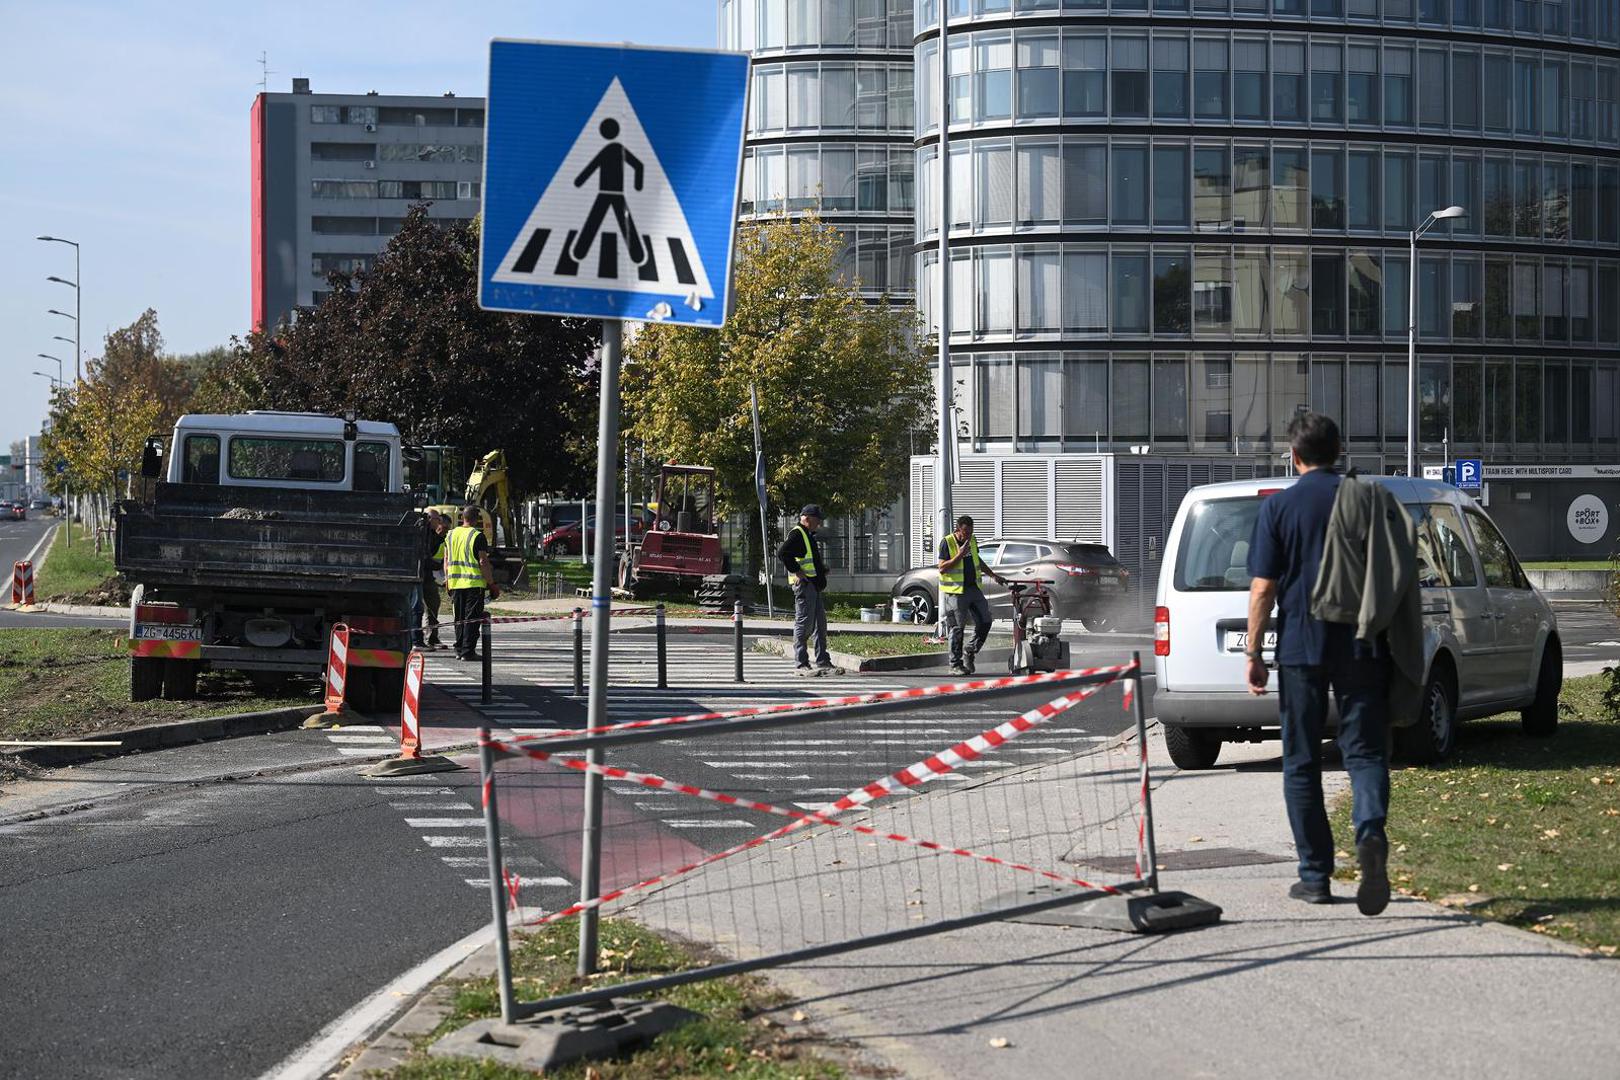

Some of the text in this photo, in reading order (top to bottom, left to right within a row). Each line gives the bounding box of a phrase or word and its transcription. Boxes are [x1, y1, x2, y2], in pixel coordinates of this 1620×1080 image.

[1462, 466, 1474, 481] P
[1485, 467, 1572, 475] TRAIN HERE WITH MULTISPORT CARD
[1575, 509, 1600, 518] SPORT
[144, 626, 156, 638] ZG
